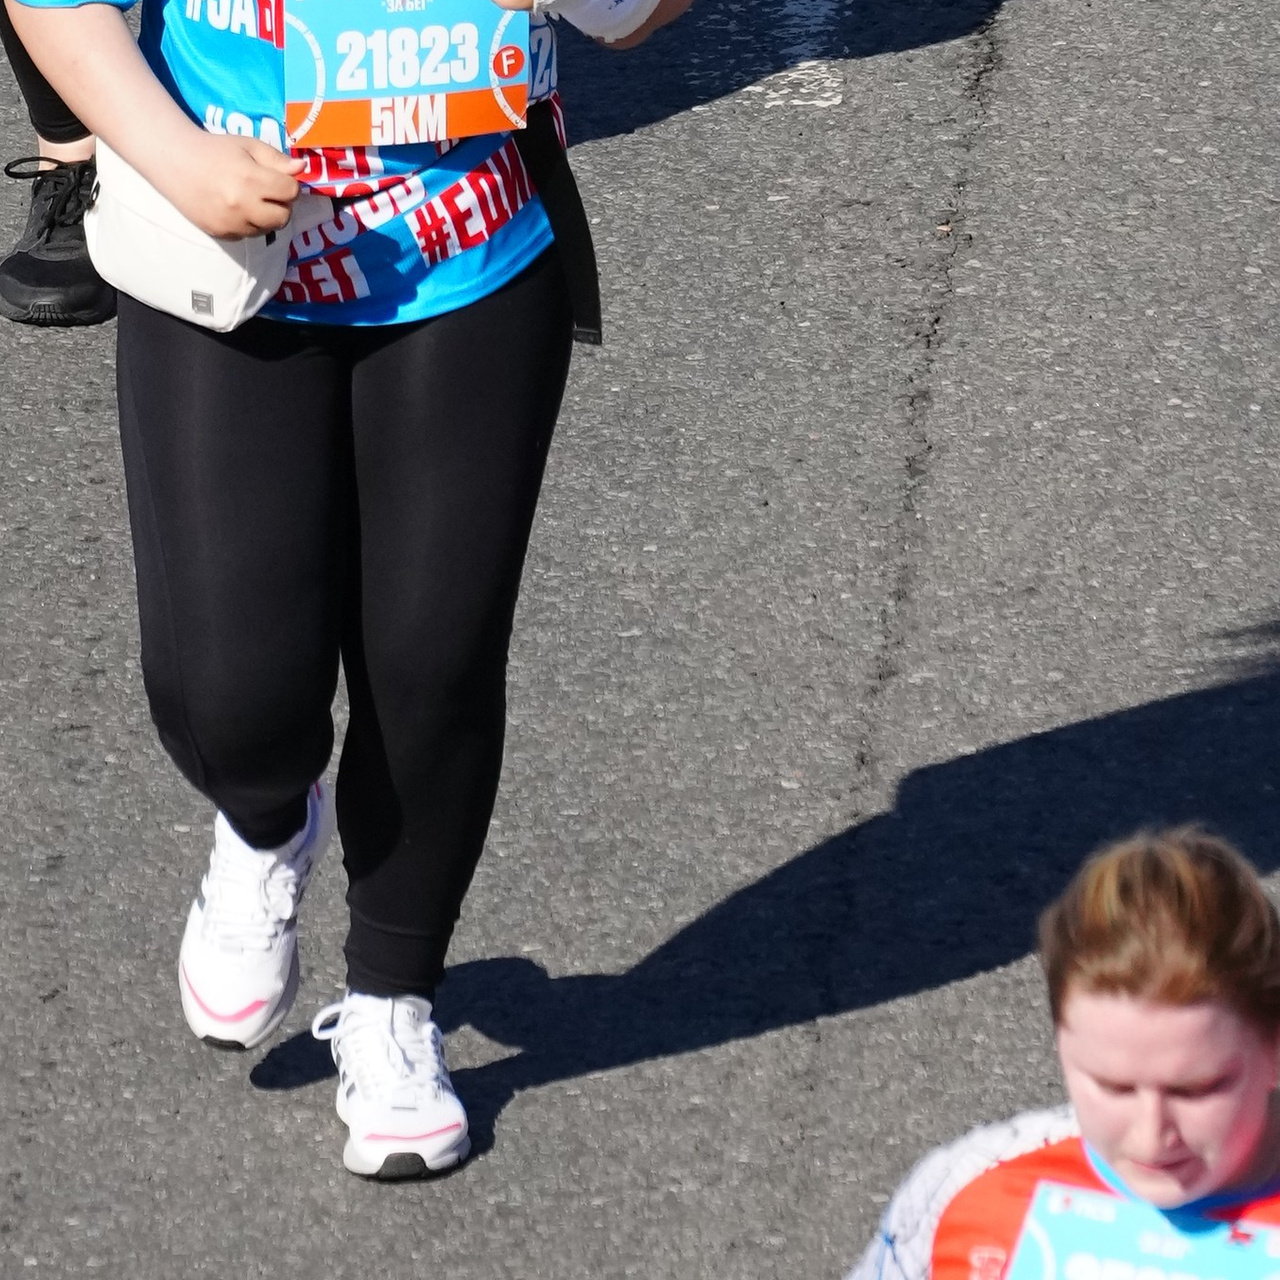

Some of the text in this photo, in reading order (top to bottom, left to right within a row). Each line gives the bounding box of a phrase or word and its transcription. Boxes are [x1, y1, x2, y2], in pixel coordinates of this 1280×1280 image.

[336, 22, 479, 92] 21823
[501, 49, 516, 77] F
[371, 93, 447, 146] 5KM
[415, 138, 539, 266] #ЕДИ
